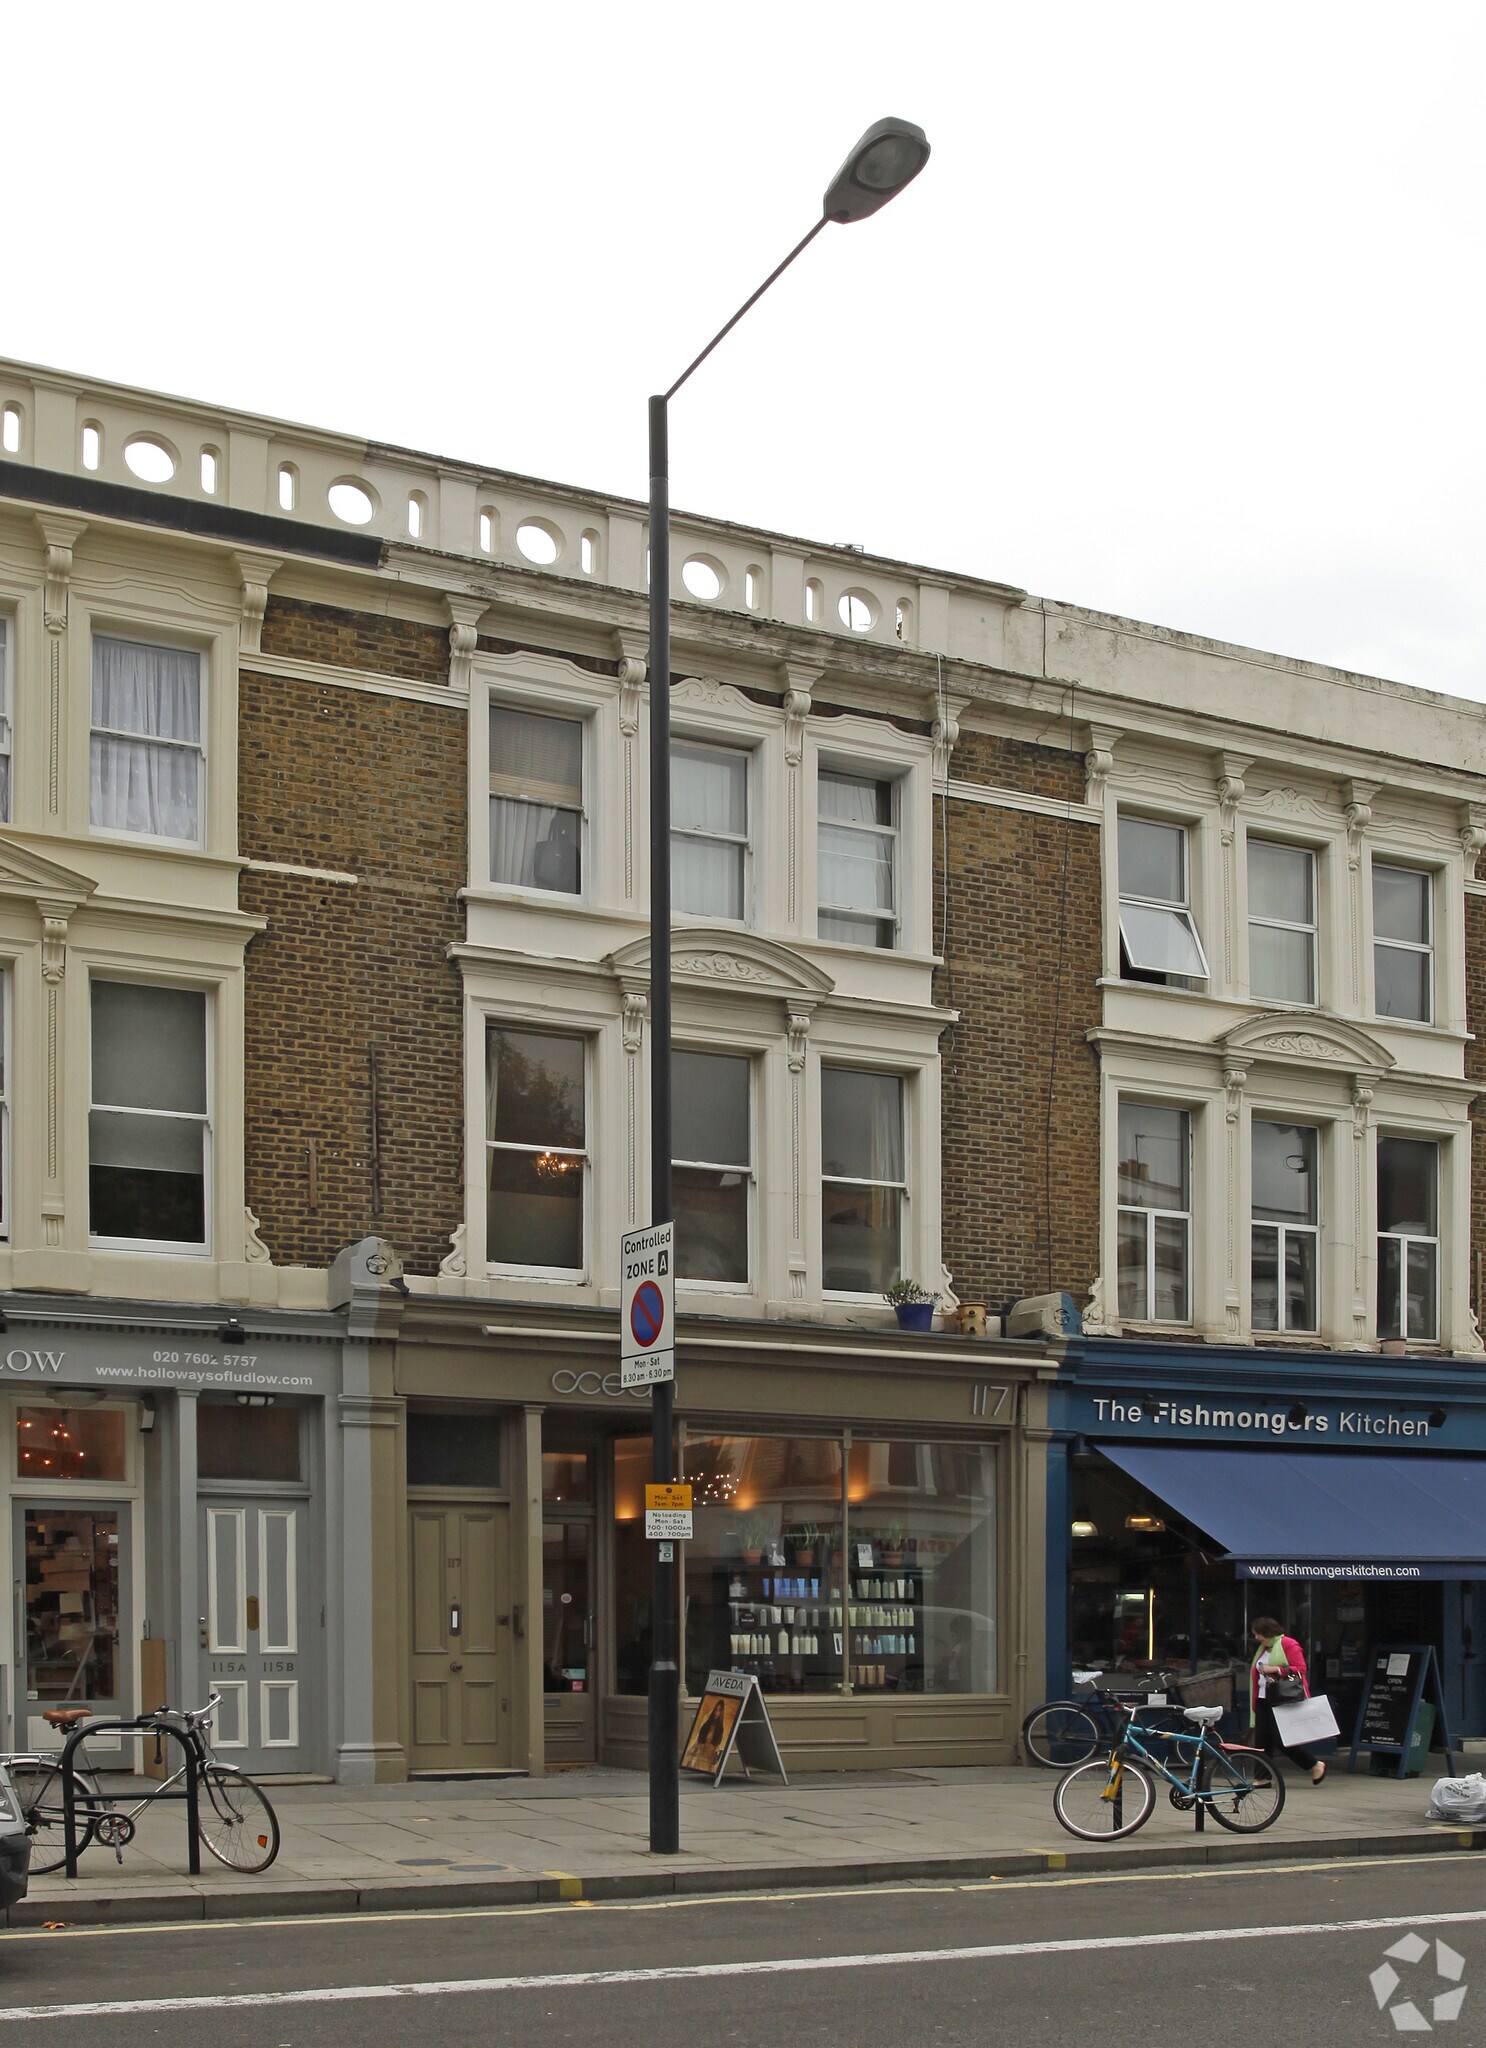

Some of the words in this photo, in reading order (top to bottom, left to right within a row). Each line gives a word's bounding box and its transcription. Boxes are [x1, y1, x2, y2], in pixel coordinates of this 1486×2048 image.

[625, 1228, 671, 1254] Controlled
[627, 1259, 654, 1279] ZONE
[659, 1254, 668, 1273] A
[0, 1349, 66, 1373] OW
[152, 1350, 180, 1364] 020
[184, 1352, 220, 1365] 7602
[223, 1354, 258, 1368] 5757
[634, 1360, 647, 1369] Mon
[650, 1357, 660, 1366] Sat
[95, 1365, 313, 1386] www.hollowaysofludlow.com
[973, 1385, 1009, 1416] 117
[1093, 1398, 1142, 1423] The
[1339, 1411, 1429, 1437] Kitchen
[1249, 1563, 1421, 1578] www.fishmongerskitchen.com
[212, 1662, 246, 1672] 115A
[263, 1661, 295, 1672] 115B
[712, 1677, 744, 1690] AVEDA
